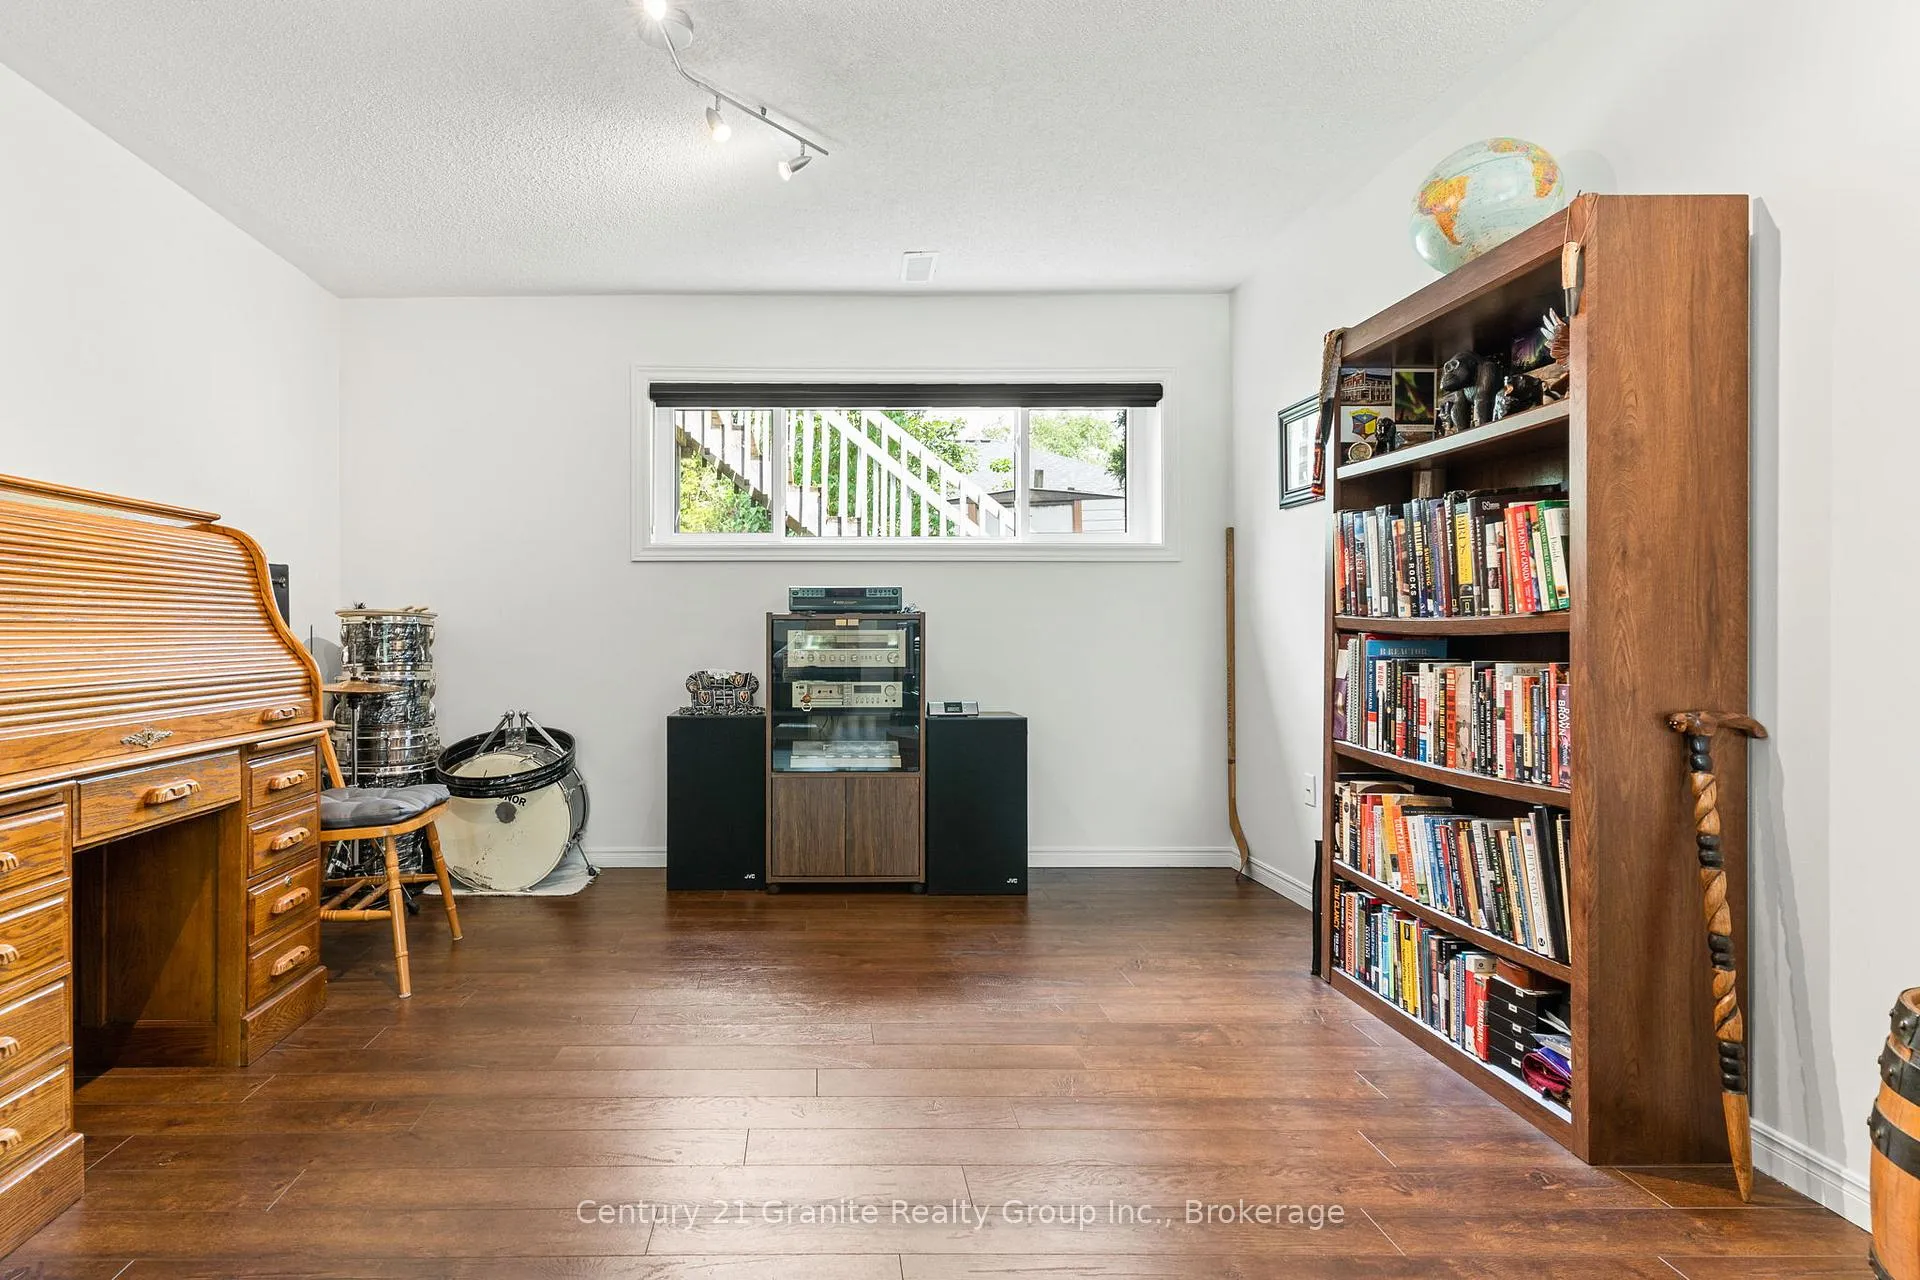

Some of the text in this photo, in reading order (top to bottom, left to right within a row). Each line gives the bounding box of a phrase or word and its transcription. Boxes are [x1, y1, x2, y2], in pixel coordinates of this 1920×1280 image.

[1413, 521, 1423, 556] DRILLING
[1446, 518, 1454, 551] Animals
[1517, 528, 1527, 552] PLANTS
[1356, 540, 1364, 580] EARTH
[1424, 548, 1432, 586] SURVEYING
[1521, 556, 1530, 583] CANADA
[1408, 563, 1417, 596] ROCKS
[1387, 647, 1428, 656] REACTOR
[1558, 700, 1566, 736] BROWN
[503, 794, 527, 807] NOR
[1489, 838, 1497, 860] SILENT
[1493, 861, 1501, 885] SPRING
[1527, 849, 1539, 907] FIFTY STATES
[1477, 1000, 1485, 1043] CANADIAN
